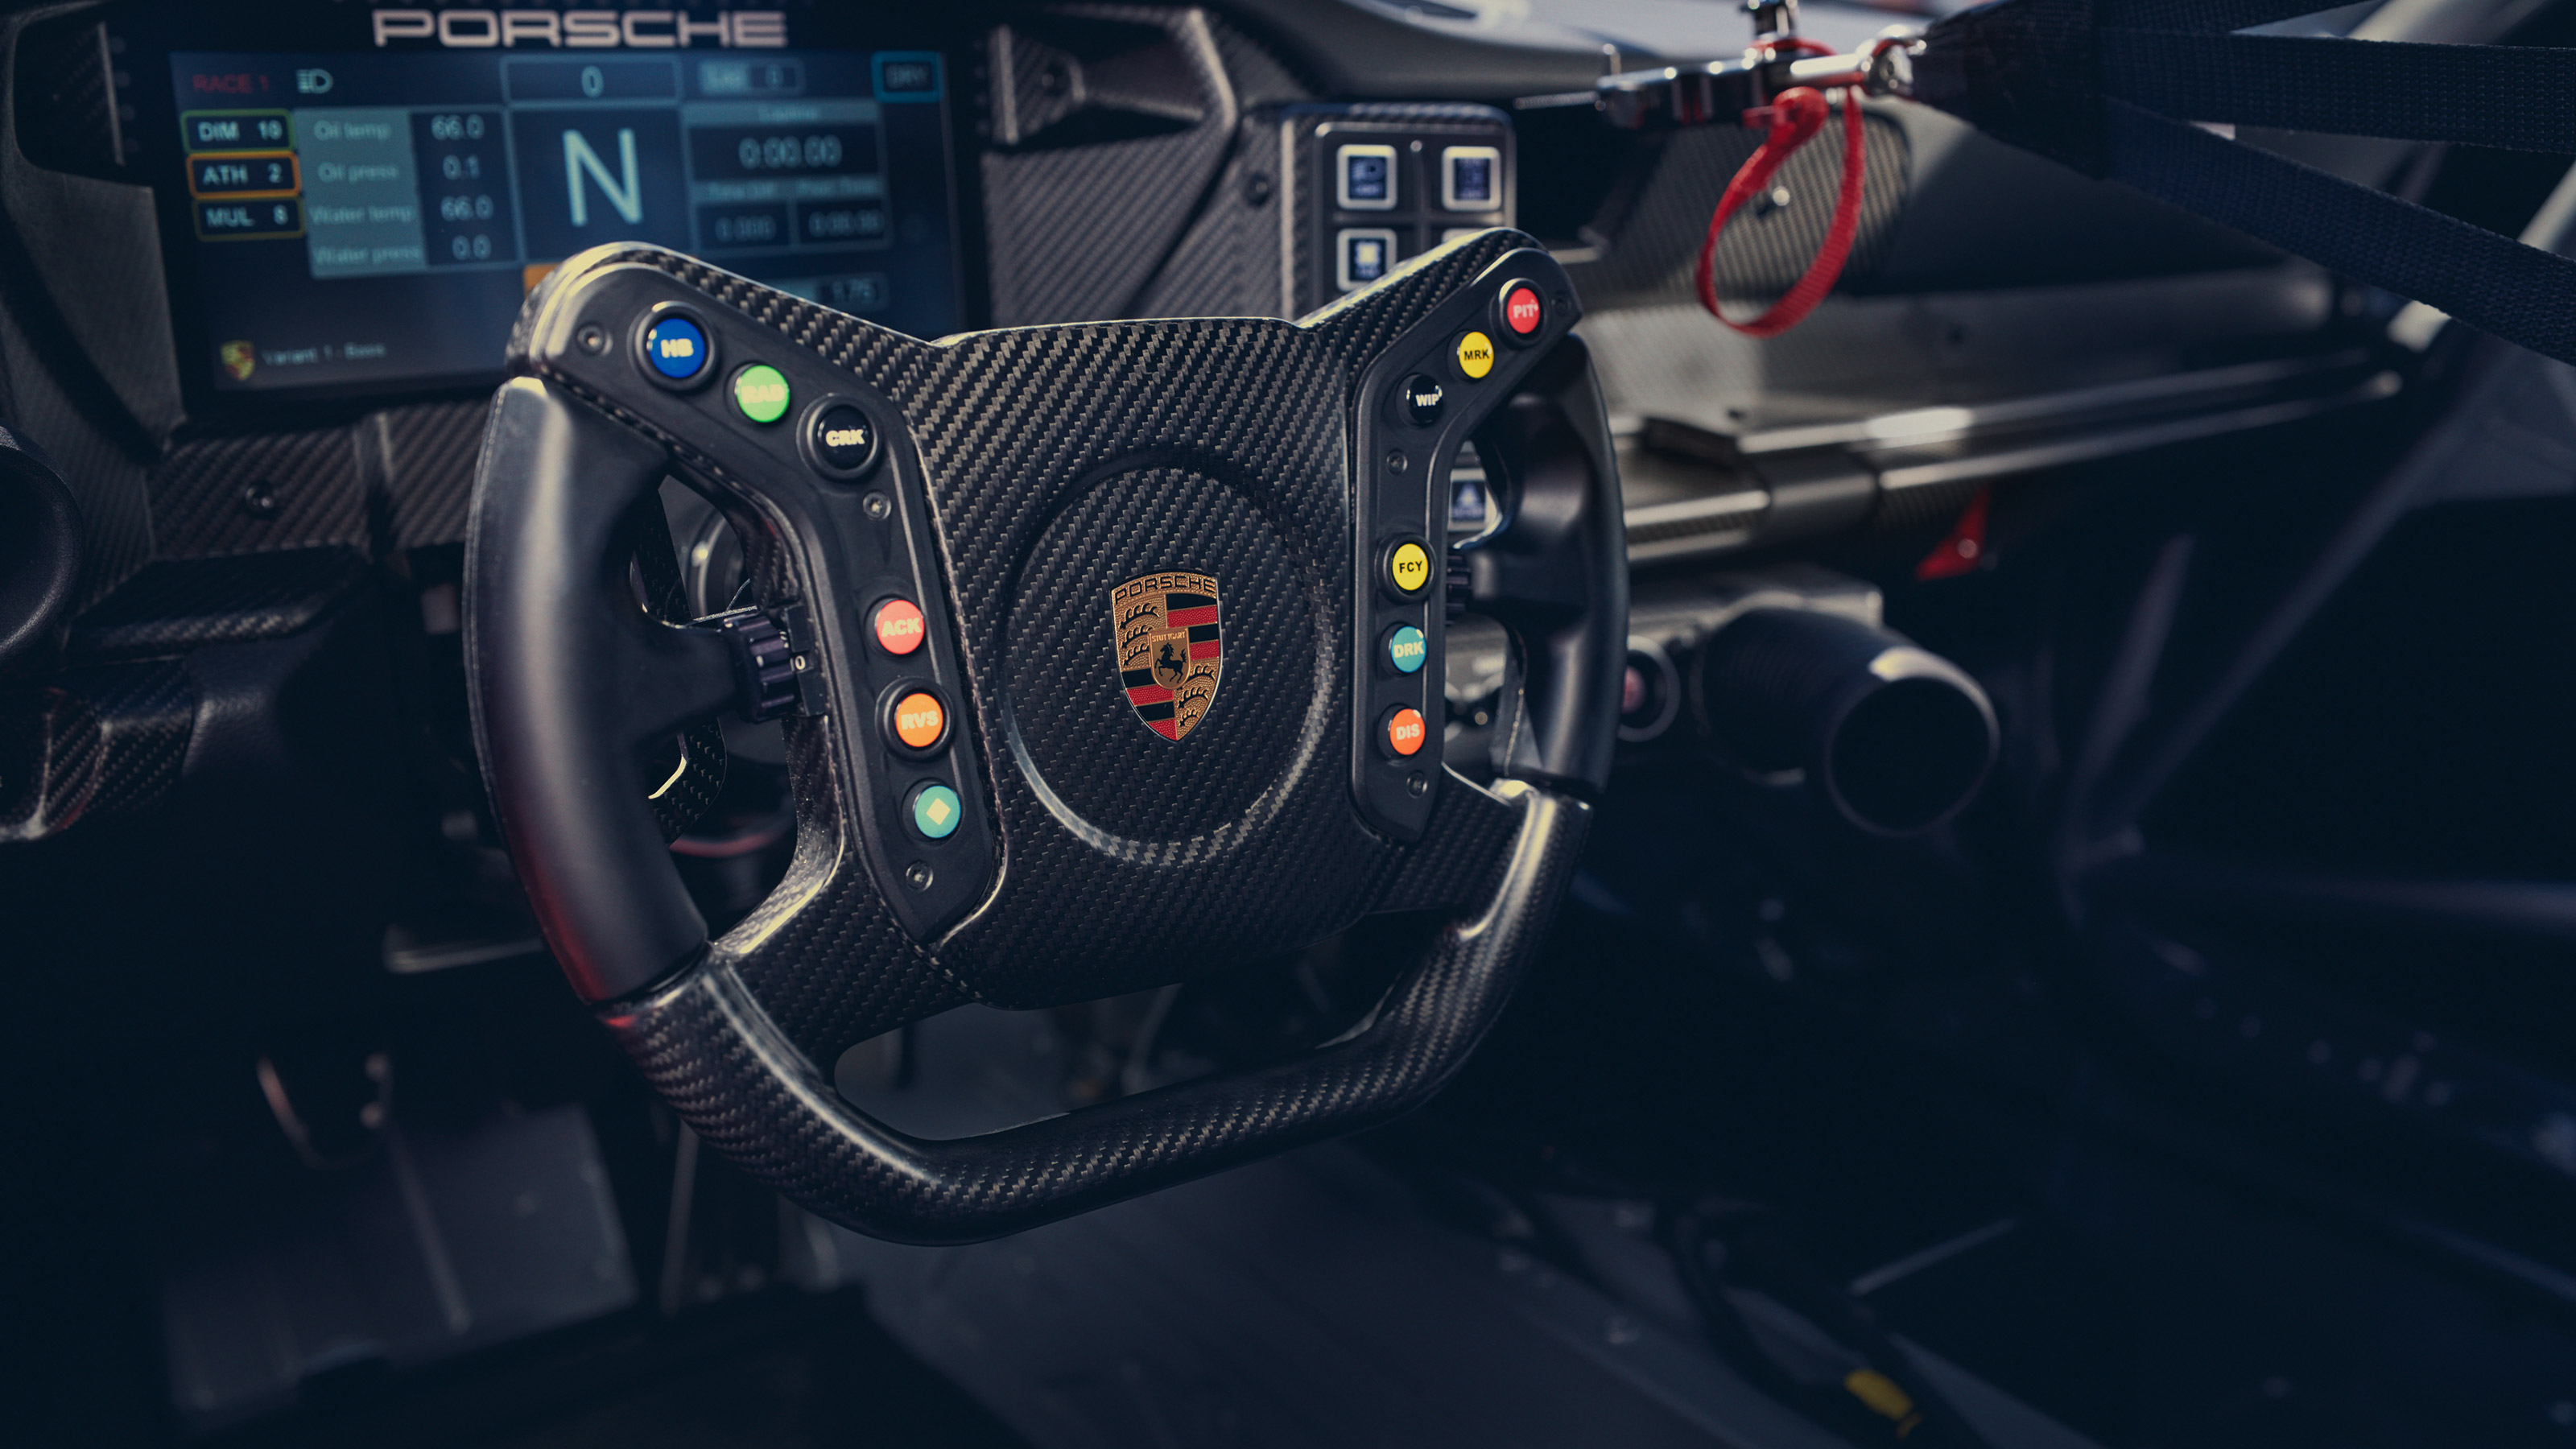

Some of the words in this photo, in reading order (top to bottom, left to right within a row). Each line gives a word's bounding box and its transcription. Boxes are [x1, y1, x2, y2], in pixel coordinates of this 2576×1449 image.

[372, 10, 787, 47] PORSCHE
[192, 74, 252, 93] RACE
[259, 75, 270, 92] 1
[581, 65, 604, 97] 0
[197, 121, 240, 142] DIM
[431, 114, 485, 140] 66.0
[203, 164, 249, 185] ATH
[267, 163, 283, 184] 2
[443, 155, 481, 180] 0.1
[563, 128, 642, 227] N
[206, 207, 255, 227] MUL
[440, 195, 493, 221] 66.0
[452, 234, 492, 261] 0.0
[1513, 305, 1535, 319] PIT
[661, 338, 694, 358] HB
[1463, 349, 1489, 361] MRK
[741, 384, 786, 404] RAD
[1415, 394, 1439, 407] WIP
[825, 428, 865, 447] CRK
[1399, 561, 1422, 573] FCY
[1115, 576, 1216, 605] PORSCHE
[881, 617, 922, 638] ACK
[1151, 631, 1187, 642] STUTTGART
[1393, 641, 1425, 658] DRK
[900, 710, 939, 730] RVS
[1396, 724, 1420, 741] DIS
